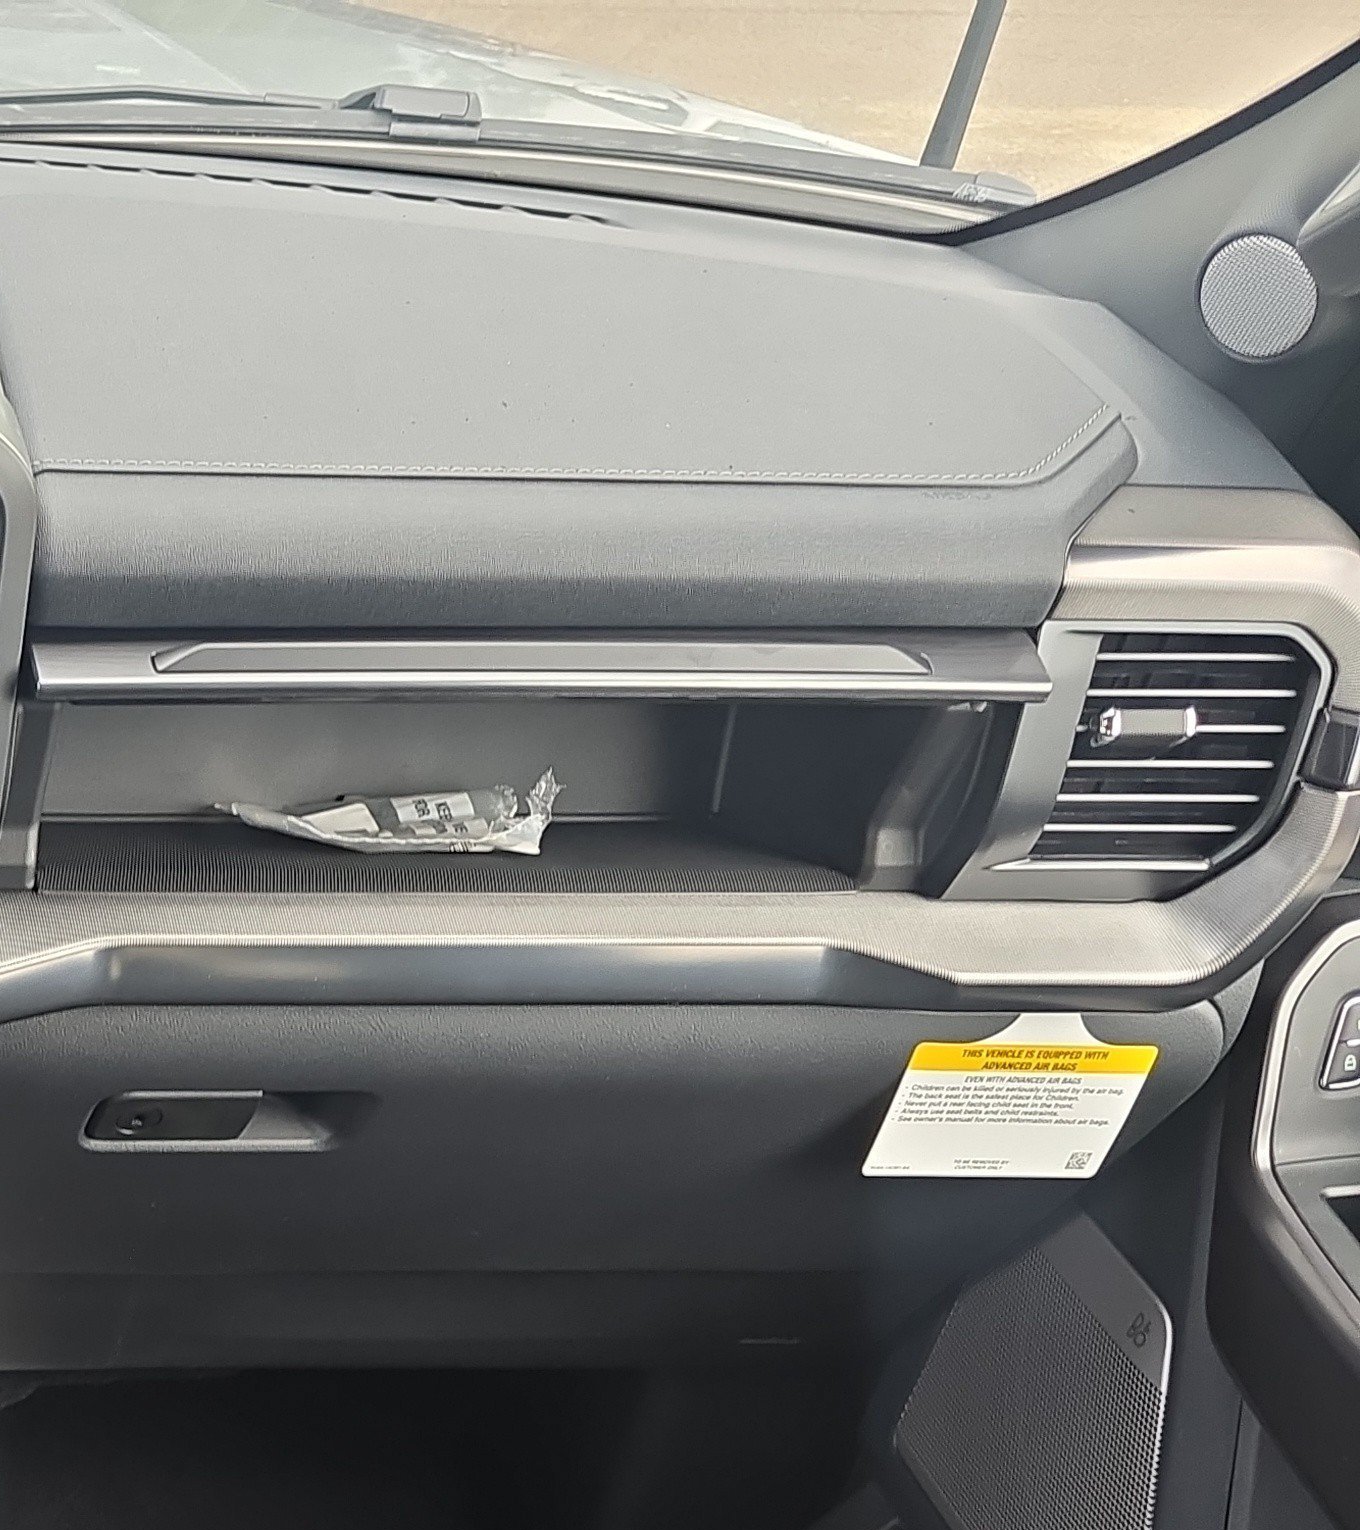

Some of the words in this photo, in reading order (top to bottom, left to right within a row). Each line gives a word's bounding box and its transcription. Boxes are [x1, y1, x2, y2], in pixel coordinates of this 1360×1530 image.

[962, 1049, 984, 1058] THIS
[986, 1049, 1023, 1058] VEHICLE
[1024, 1049, 1035, 1058] IS
[1037, 1050, 1081, 1059] EQUIPPED
[1084, 1051, 1109, 1060] WITH
[981, 1062, 1031, 1070] ADVANCED
[1033, 1063, 1049, 1071] AIR
[1051, 1063, 1078, 1071] BAGS
